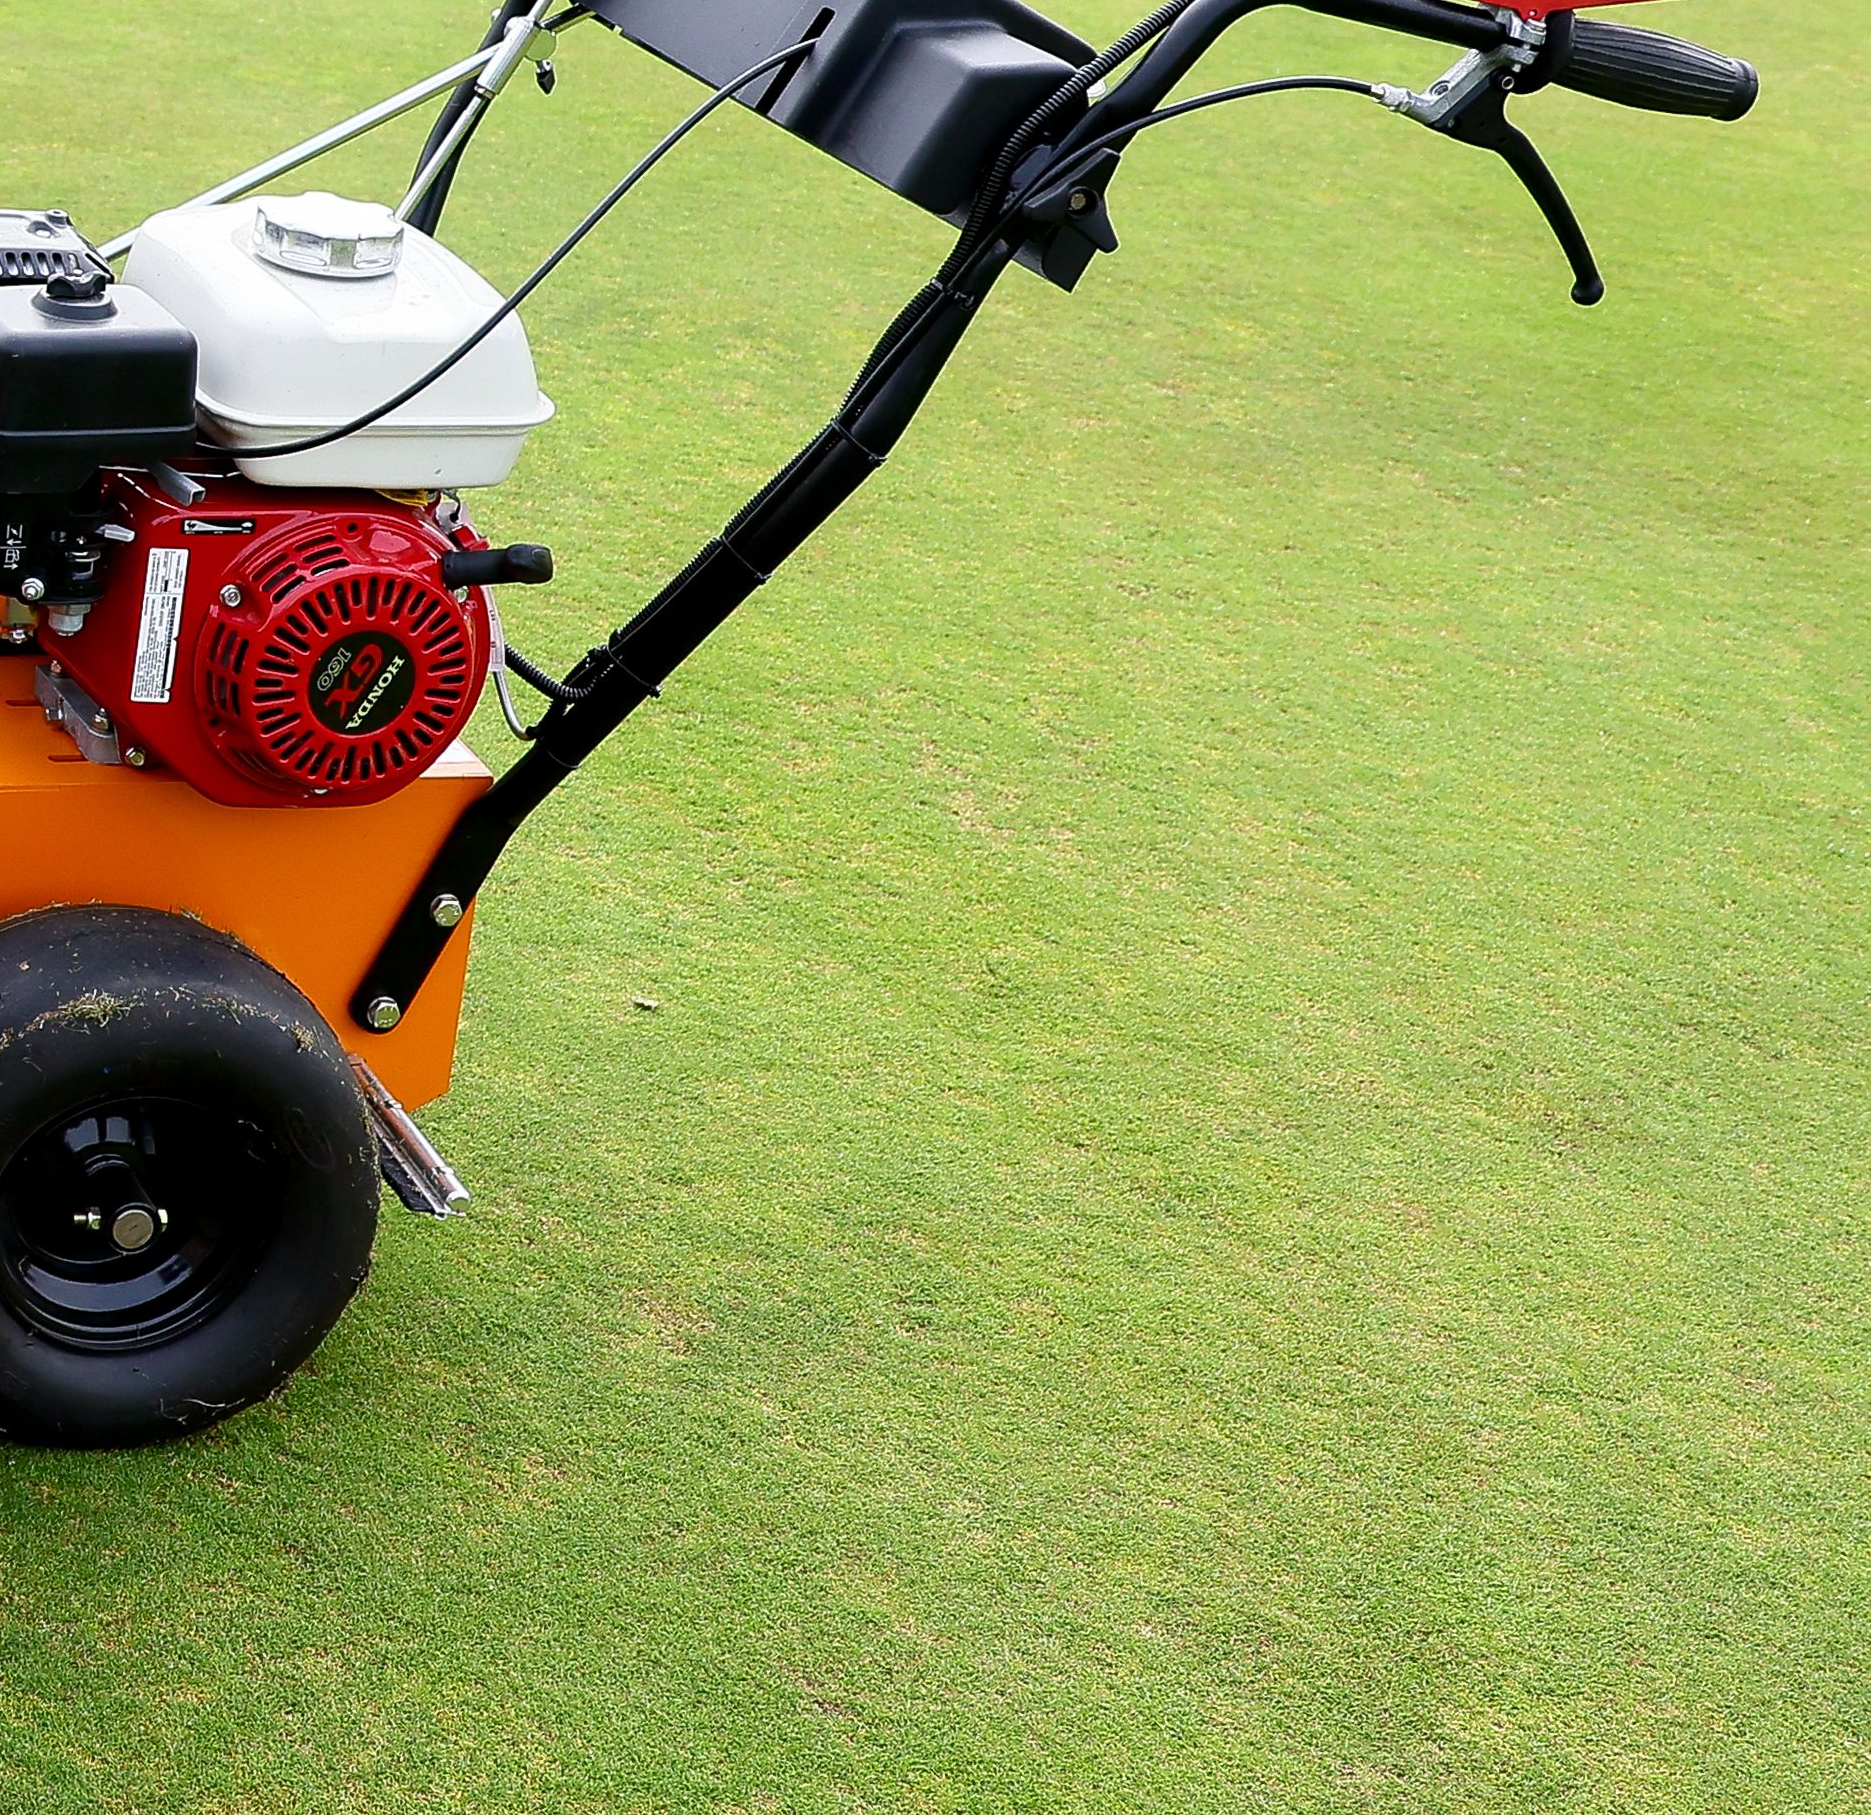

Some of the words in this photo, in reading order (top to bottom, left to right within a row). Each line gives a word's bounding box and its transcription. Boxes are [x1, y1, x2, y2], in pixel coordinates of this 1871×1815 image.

[317, 647, 352, 691] 160
[324, 644, 382, 719] GX
[345, 655, 405, 729] HONDA
